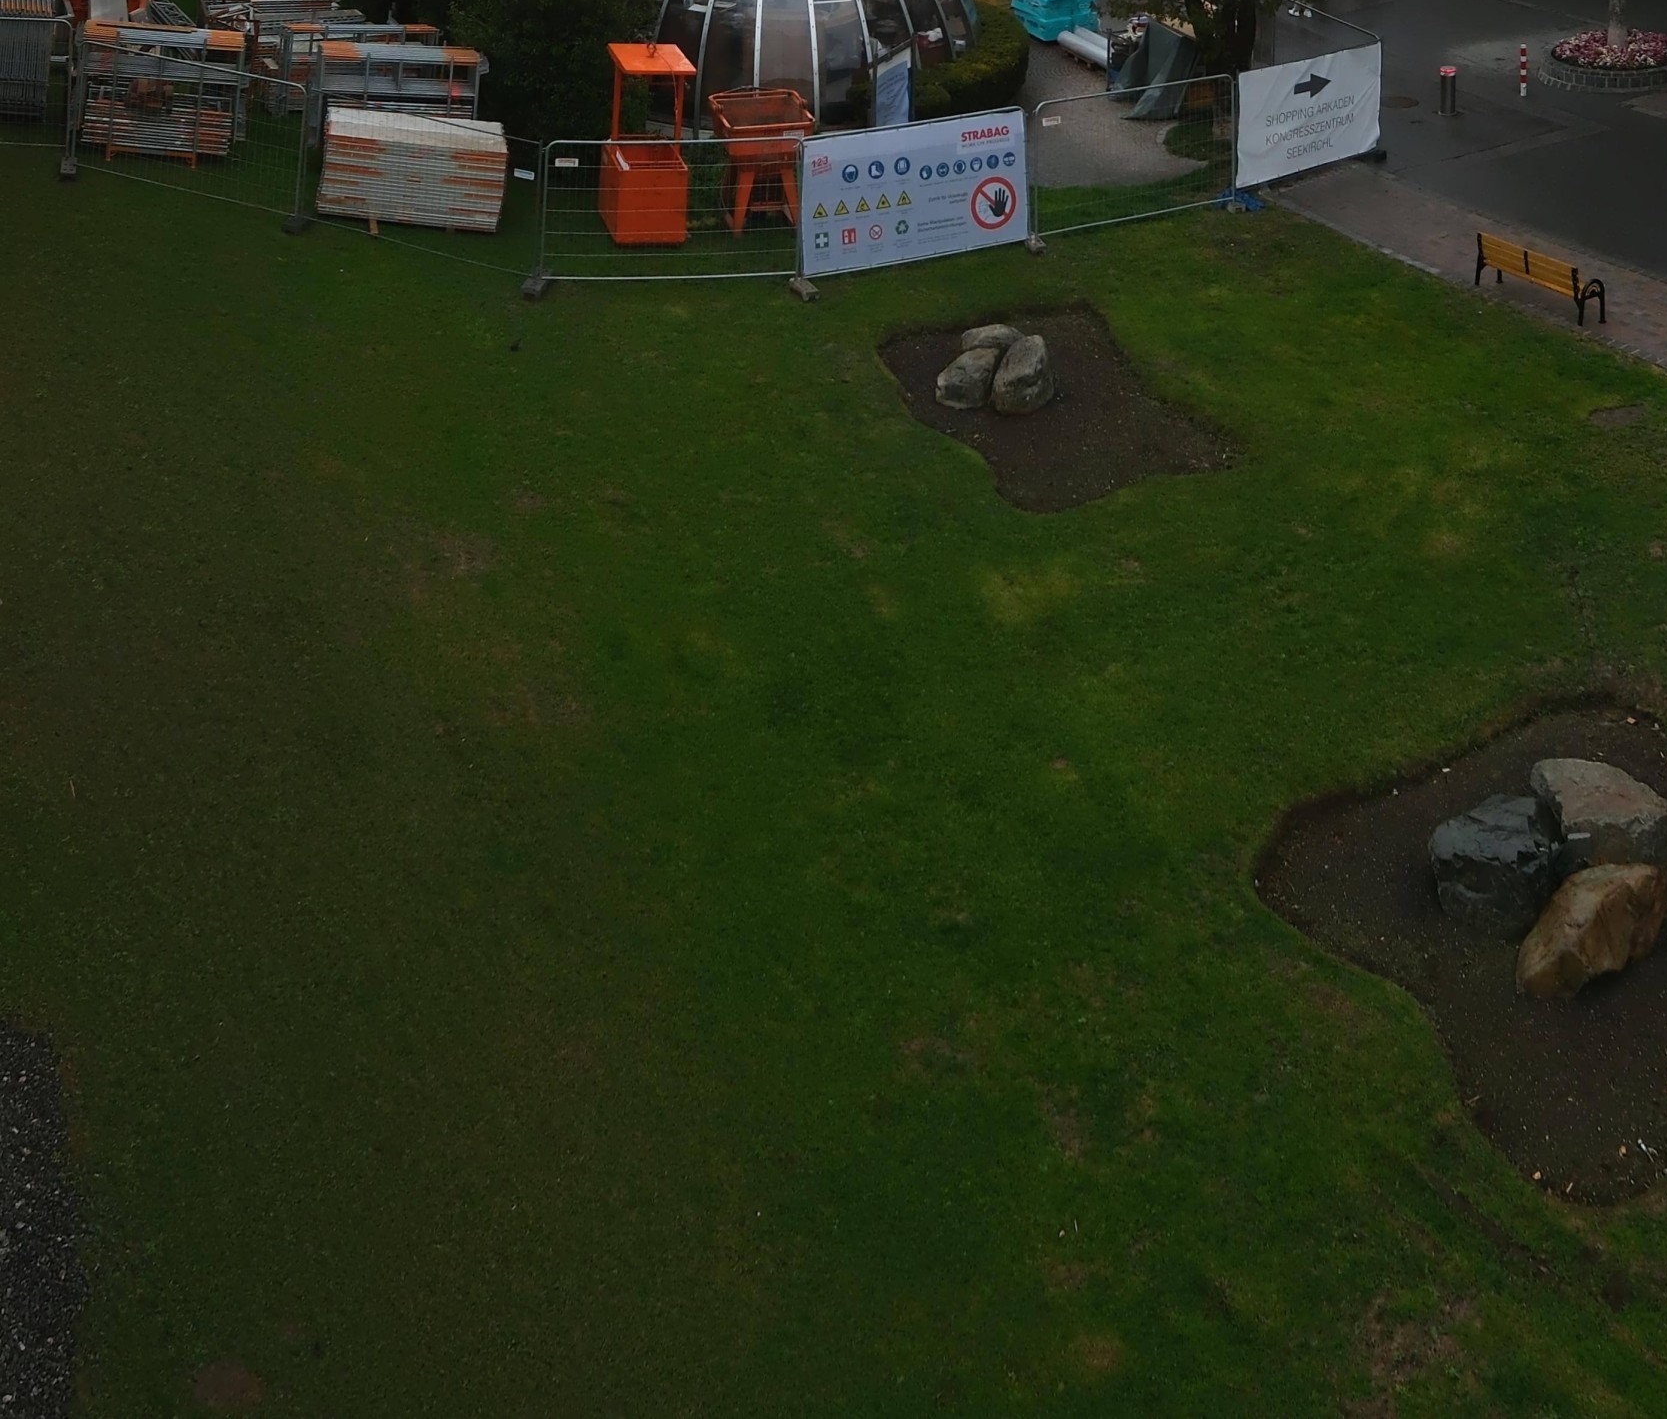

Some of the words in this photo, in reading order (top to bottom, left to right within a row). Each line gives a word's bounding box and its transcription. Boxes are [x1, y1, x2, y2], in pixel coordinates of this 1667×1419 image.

[1265, 106, 1315, 127] SHOPPING
[1316, 95, 1355, 114] ARKADEN
[961, 125, 1010, 142] STRABAG
[1265, 113, 1355, 145] KONGRESSZENTRUM
[1286, 136, 1334, 159] SEEKIRCHL
